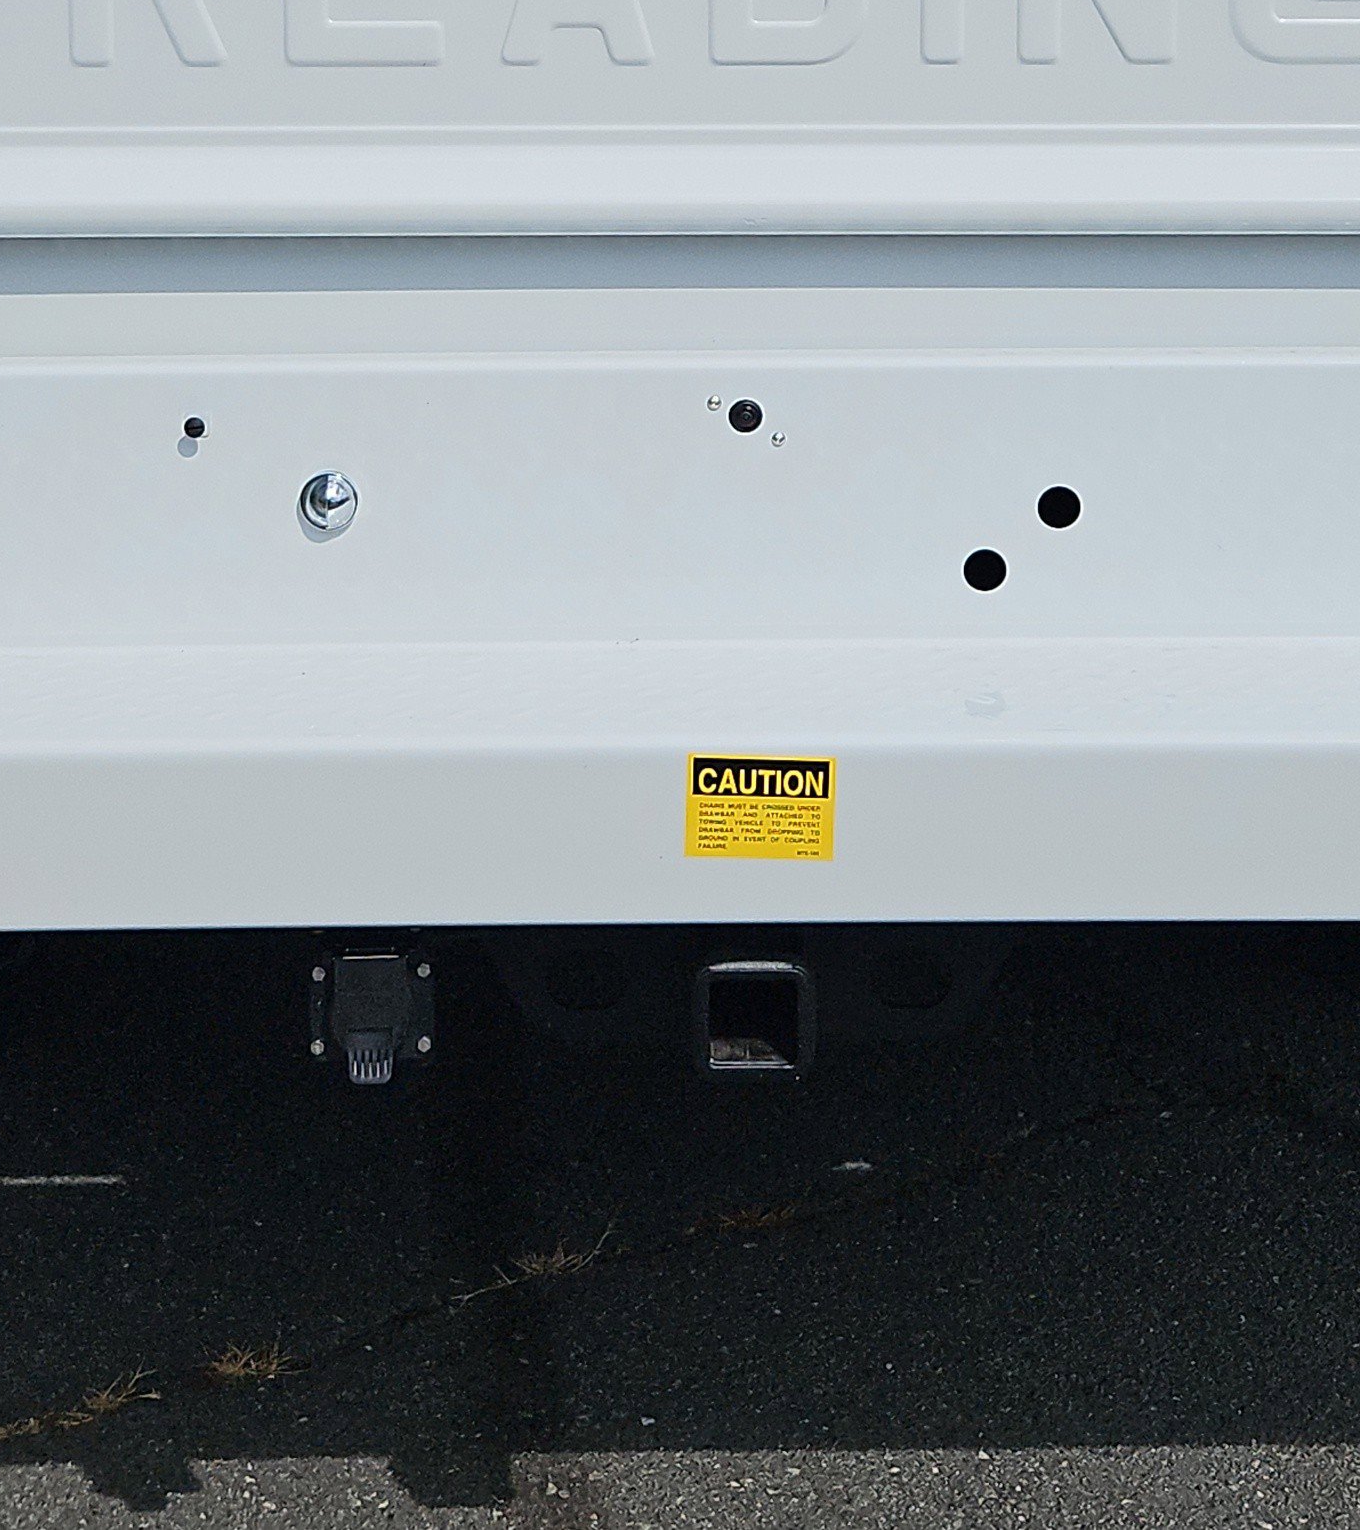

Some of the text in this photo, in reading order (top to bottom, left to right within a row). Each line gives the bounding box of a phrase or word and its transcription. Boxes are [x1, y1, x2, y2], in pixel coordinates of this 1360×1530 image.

[697, 767, 825, 797] CAUTION
[728, 802, 747, 810] MUST
[797, 804, 821, 812] UNDER
[698, 818, 727, 826] TOWING
[767, 828, 804, 836] DROPPING
